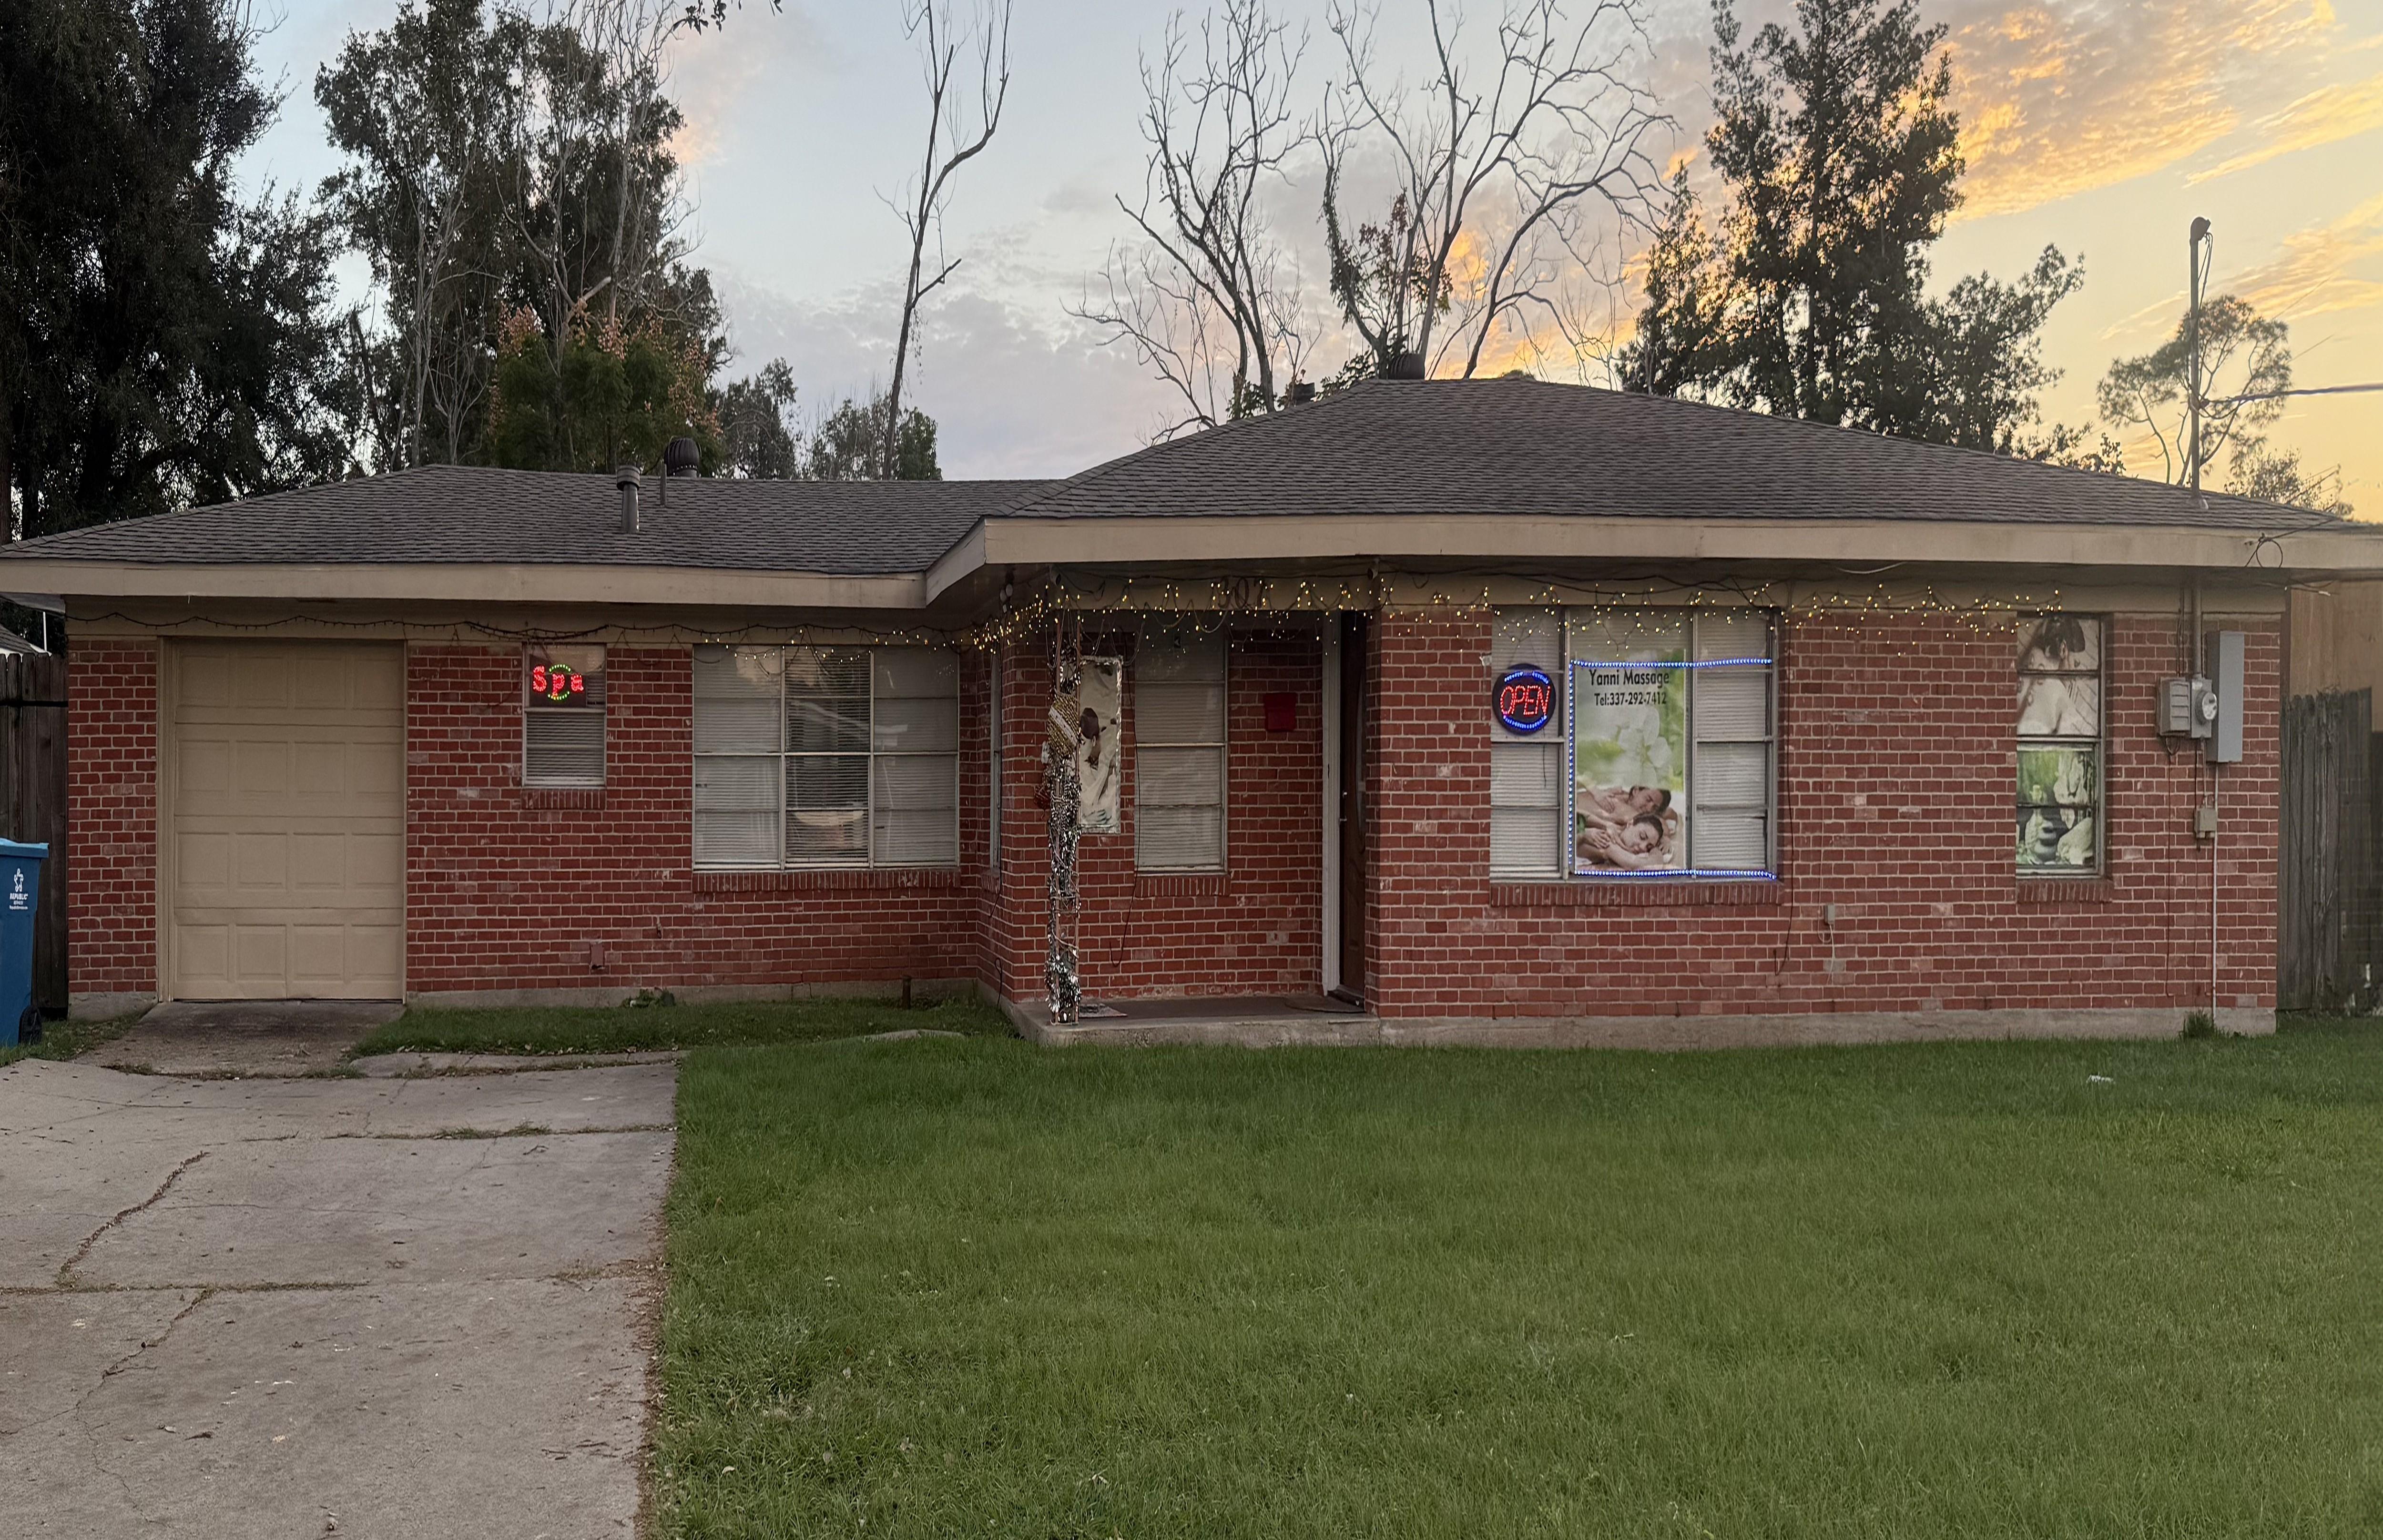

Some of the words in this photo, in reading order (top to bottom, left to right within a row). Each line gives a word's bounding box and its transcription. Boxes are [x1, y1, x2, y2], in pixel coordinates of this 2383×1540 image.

[1589, 669, 1619, 686] Yanni
[1623, 669, 1670, 688] Massage
[1500, 685, 1550, 716] OPEN
[1594, 691, 1667, 707] Tel:337-292-7412
